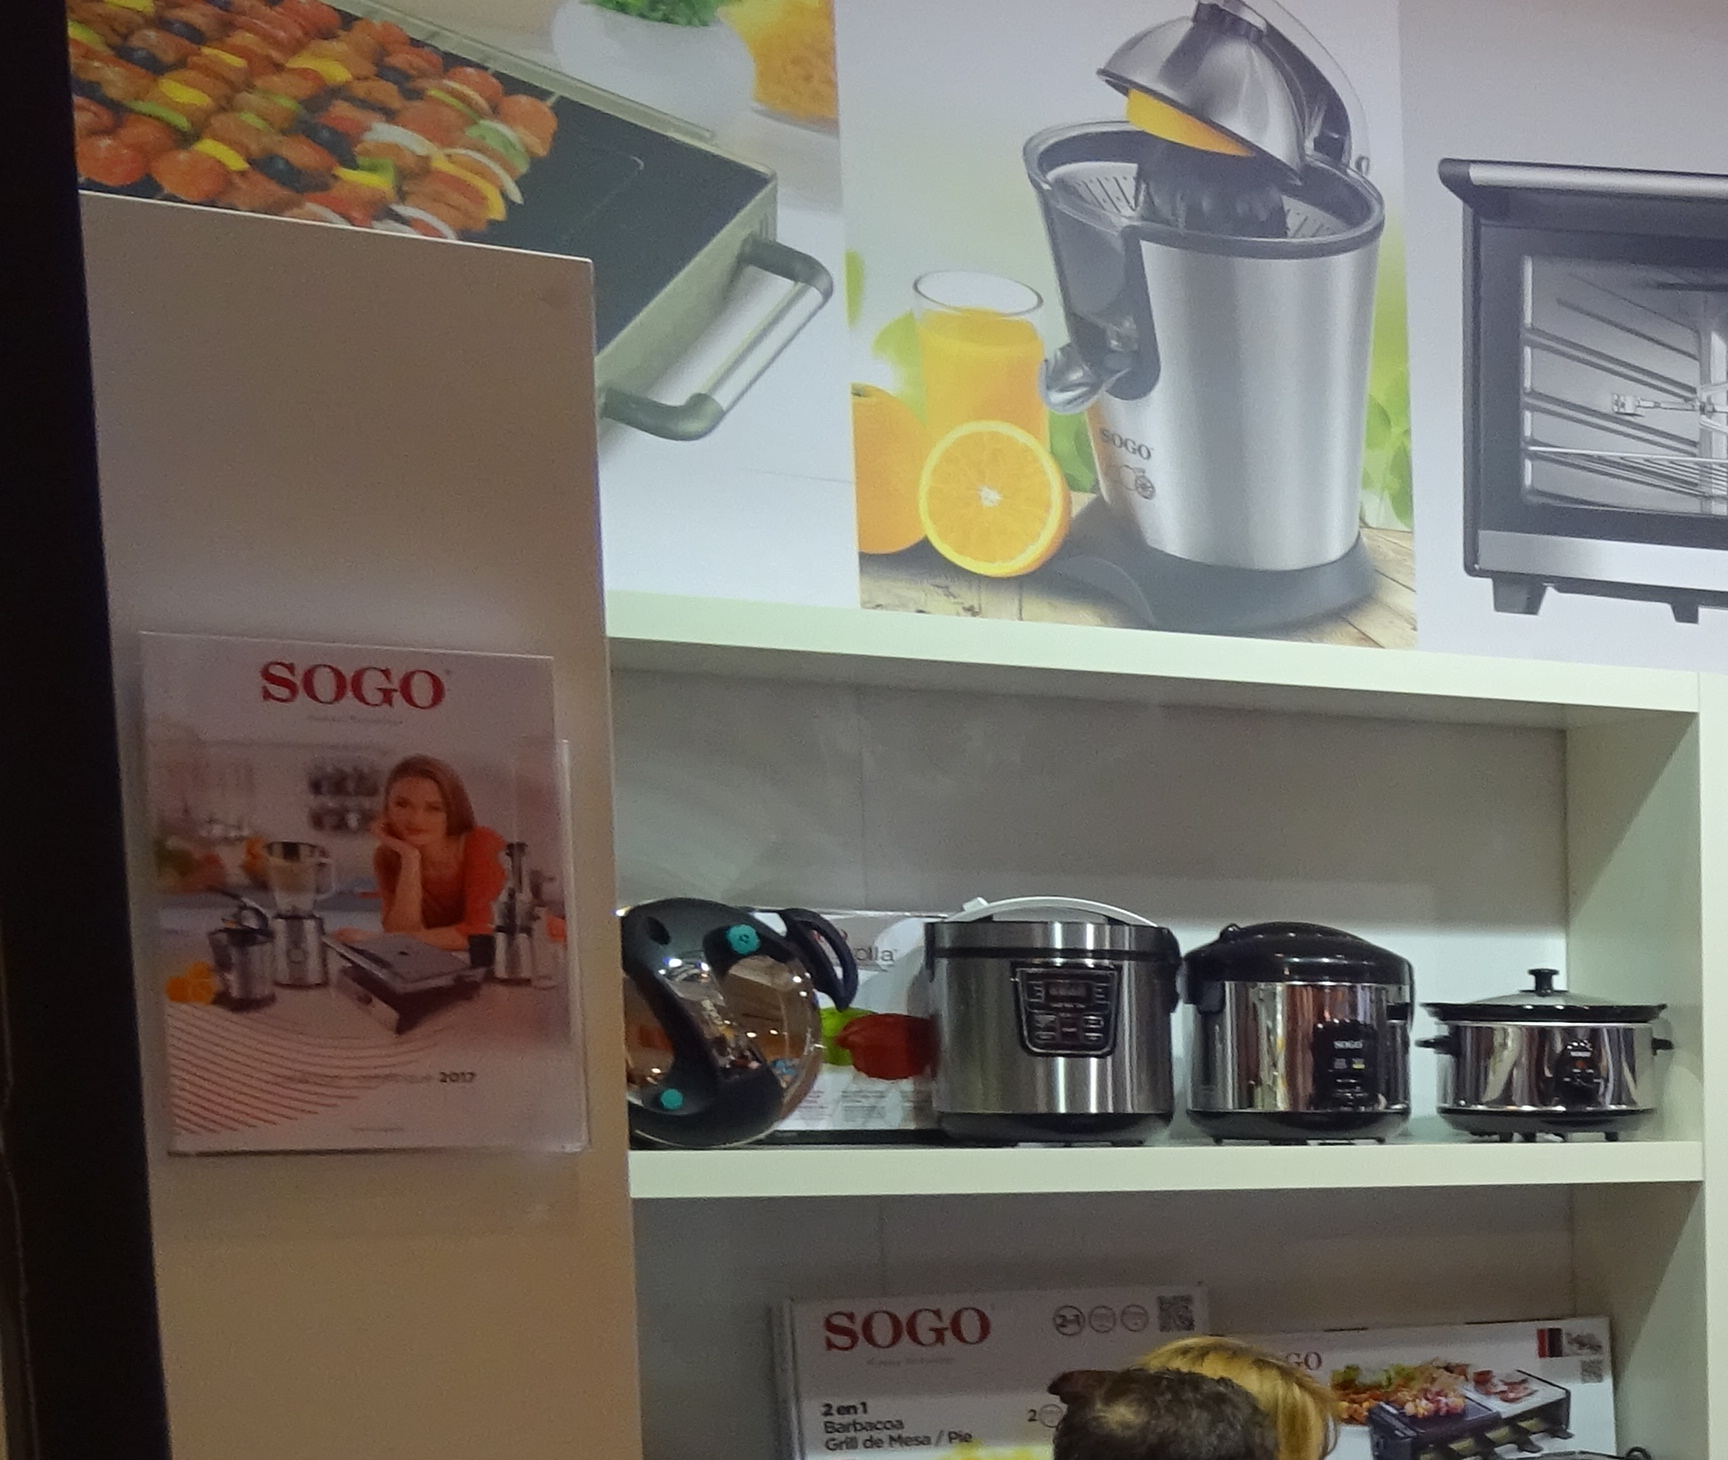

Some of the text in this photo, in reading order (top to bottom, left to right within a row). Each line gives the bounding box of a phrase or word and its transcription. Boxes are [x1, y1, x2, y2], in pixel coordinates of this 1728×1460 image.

[1100, 427, 1151, 461] SOGO
[259, 661, 446, 711] SOGO
[1333, 1039, 1363, 1050] SOGO
[823, 1306, 991, 1352] SOGO
[1287, 1350, 1323, 1371] GO
[822, 1402, 868, 1416] 2 en 1
[1027, 1409, 1037, 1423] 2
[824, 1418, 905, 1434] Barbacoa
[825, 1434, 858, 1452] Grill
[864, 1434, 884, 1449] de
[887, 1433, 932, 1448] Mesa
[947, 1431, 974, 1444] Pie
